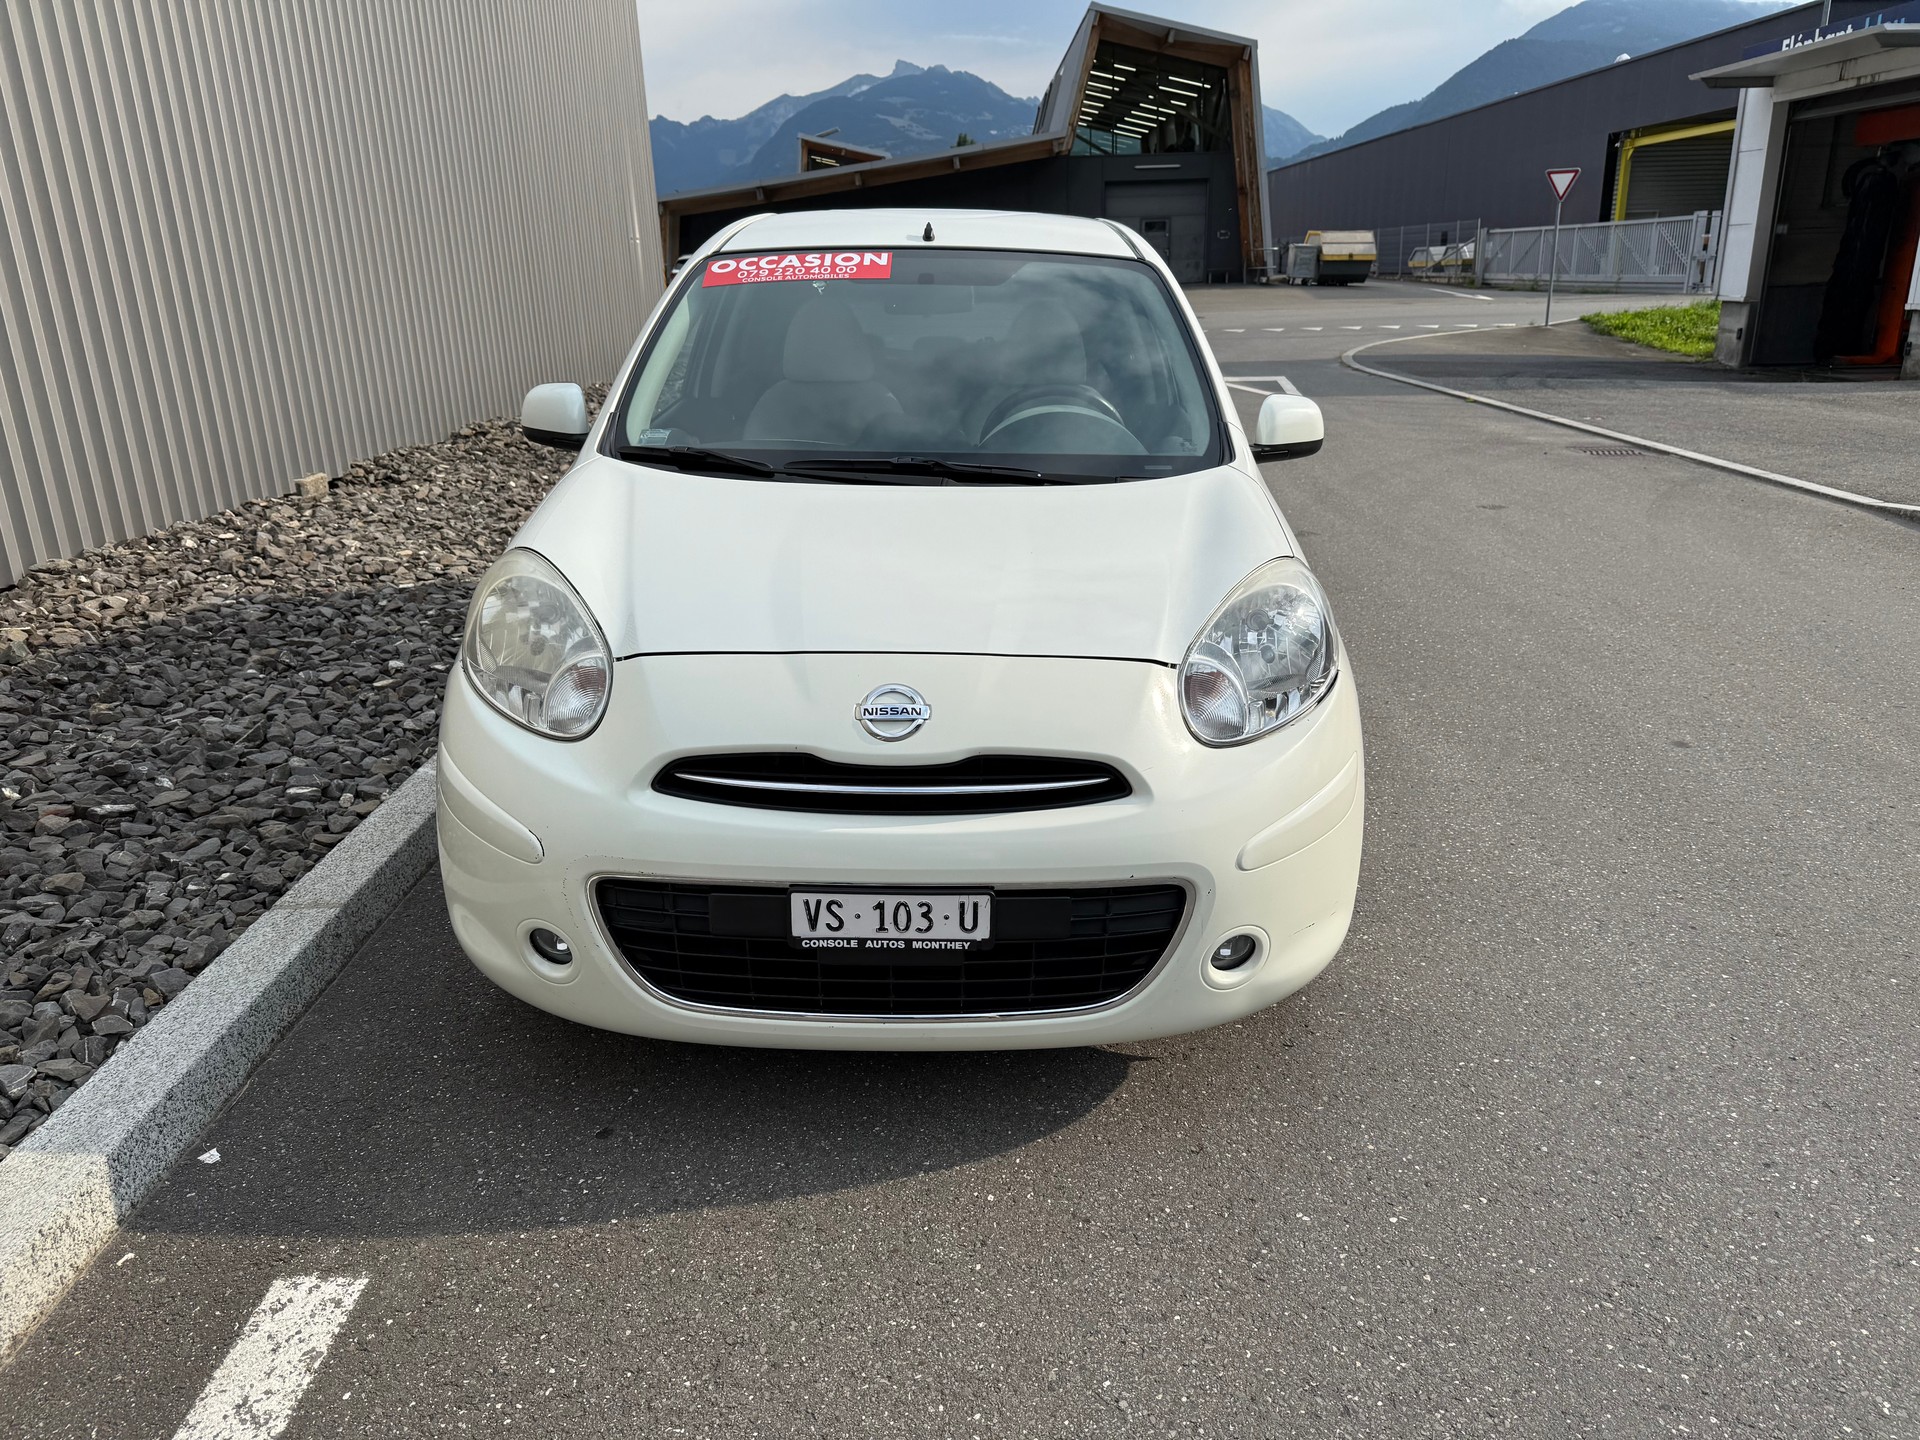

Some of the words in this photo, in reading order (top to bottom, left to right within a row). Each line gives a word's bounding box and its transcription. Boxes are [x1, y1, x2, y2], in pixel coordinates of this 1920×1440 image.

[711, 252, 889, 273] OCCASION
[737, 268, 769, 279] 079
[773, 266, 805, 276] 220
[809, 265, 831, 275] 40
[836, 265, 857, 274] 00
[742, 275, 783, 283] CONSOLE
[863, 707, 922, 716] NISSAN
[801, 939, 858, 948] CONSOLE
[865, 940, 905, 949] AUTOS
[912, 940, 971, 950] MONTHEY
